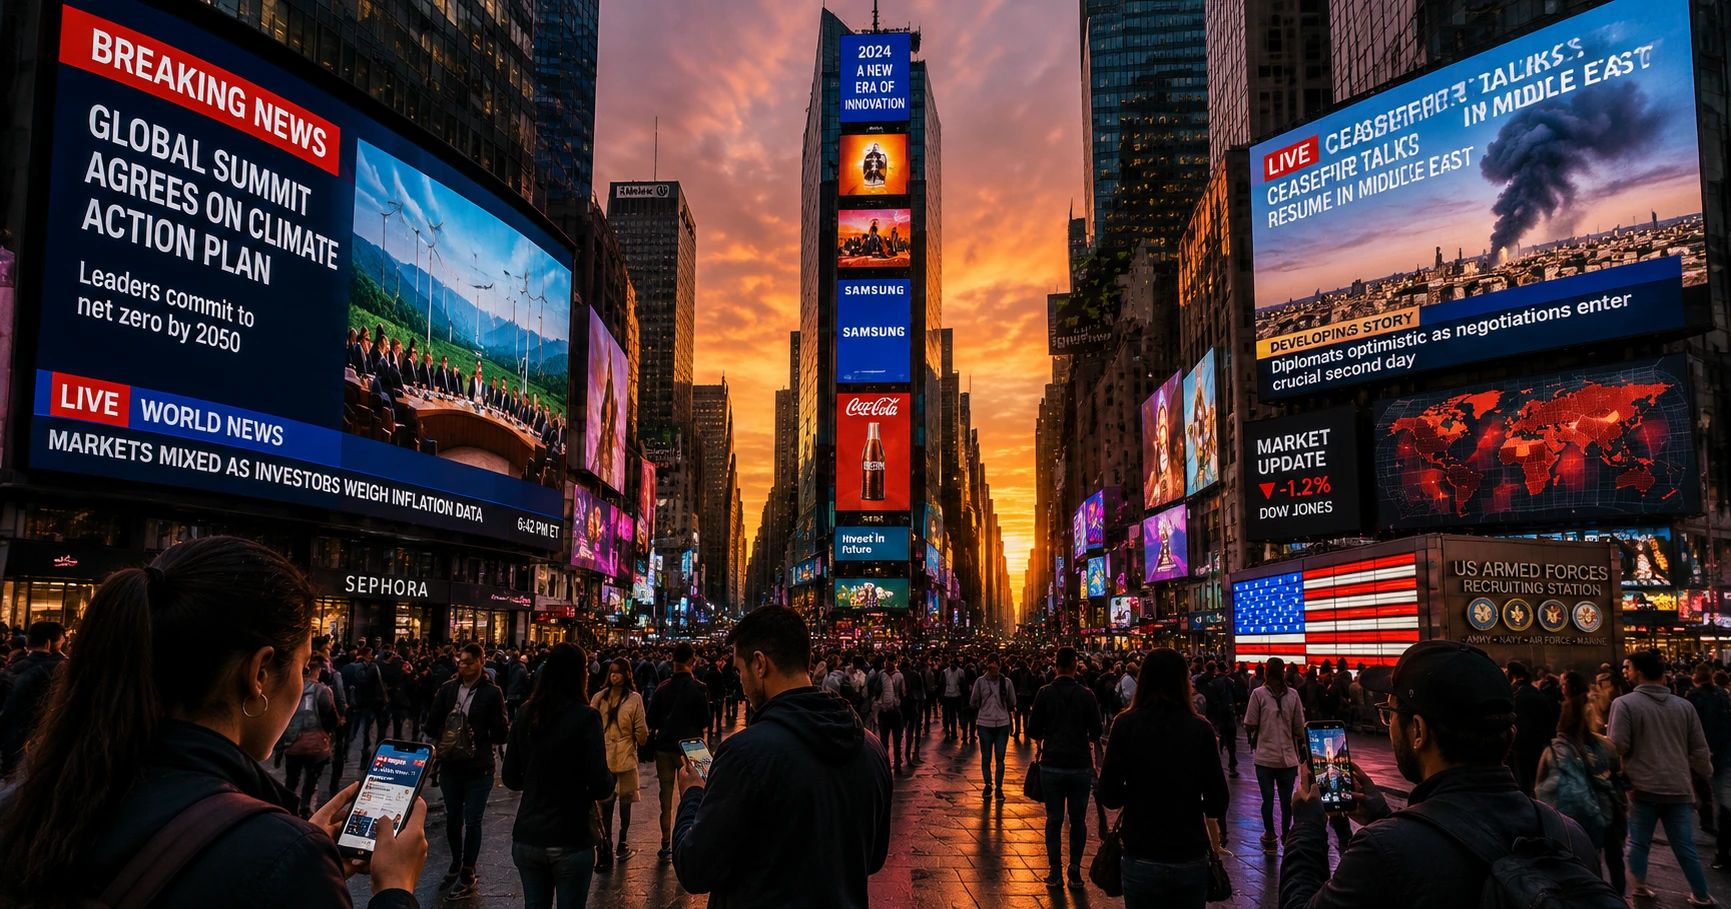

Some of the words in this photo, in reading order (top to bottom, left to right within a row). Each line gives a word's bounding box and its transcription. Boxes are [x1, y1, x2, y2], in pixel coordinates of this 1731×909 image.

[858, 45, 891, 59] 2024
[856, 65, 866, 77] A
[867, 64, 893, 77] NEW
[91, 28, 246, 118] BREAKING
[254, 100, 327, 158] NEWS
[855, 81, 877, 94] ERA
[880, 80, 895, 93] OF
[845, 98, 905, 110] INNOVATION
[89, 104, 205, 175] GLOBAL
[213, 149, 312, 216] SUMMIT
[1268, 143, 1310, 176] LIVE
[1361, 133, 1419, 172] TALKS
[1268, 191, 1333, 228] RESUME
[1337, 184, 1353, 206] IN
[1429, 146, 1474, 177] EAST
[85, 152, 199, 215] AGREES
[206, 192, 242, 233] ON
[249, 209, 339, 271] CLIMATE
[82, 199, 195, 262] ACTION
[204, 236, 271, 285] PLAN
[79, 261, 160, 301] Leaders
[166, 288, 233, 323] commit
[238, 306, 254, 328] to
[845, 285, 904, 295] SAMSUNG
[77, 296, 113, 322] net
[119, 307, 162, 332] zero
[168, 314, 191, 344] by
[196, 323, 240, 353] 2050
[843, 327, 905, 337] SAMSUNG
[1272, 348, 1344, 374] Diplomats
[1347, 331, 1427, 359] optimistic
[1432, 327, 1451, 341] as
[1456, 303, 1572, 337] negotiations
[1577, 294, 1632, 315] enter
[1363, 312, 1414, 333] STORY
[1272, 368, 1321, 391] crucial
[1325, 357, 1381, 381] second
[1385, 352, 1416, 369] day
[60, 384, 119, 417] LIVE
[141, 398, 221, 434] WORLD
[227, 417, 284, 446] NEWS
[1257, 428, 1331, 455] MARKET
[1258, 450, 1326, 475] UPDATE
[48, 429, 153, 463] MARKETS
[159, 445, 222, 474] MIXED
[226, 456, 250, 478] AS
[255, 461, 340, 494] INVESTORS
[344, 478, 389, 503] WEIGH
[392, 489, 453, 516] INFLATION
[456, 503, 483, 523] DATA
[1279, 475, 1331, 497] -1.2%
[1260, 504, 1289, 520] DOW
[1292, 500, 1333, 516] JONES
[517, 516, 535, 534] 6:42
[536, 520, 548, 537] PM
[550, 522, 560, 539] ET
[1454, 560, 1478, 577] US
[1482, 561, 1540, 578] ARMED
[1545, 564, 1608, 581] FORCES
[345, 575, 428, 598] SEPHORA
[1463, 579, 1544, 594] RECRUITING
[1548, 582, 1602, 596] STATION
[1529, 636, 1543, 645] AIR
